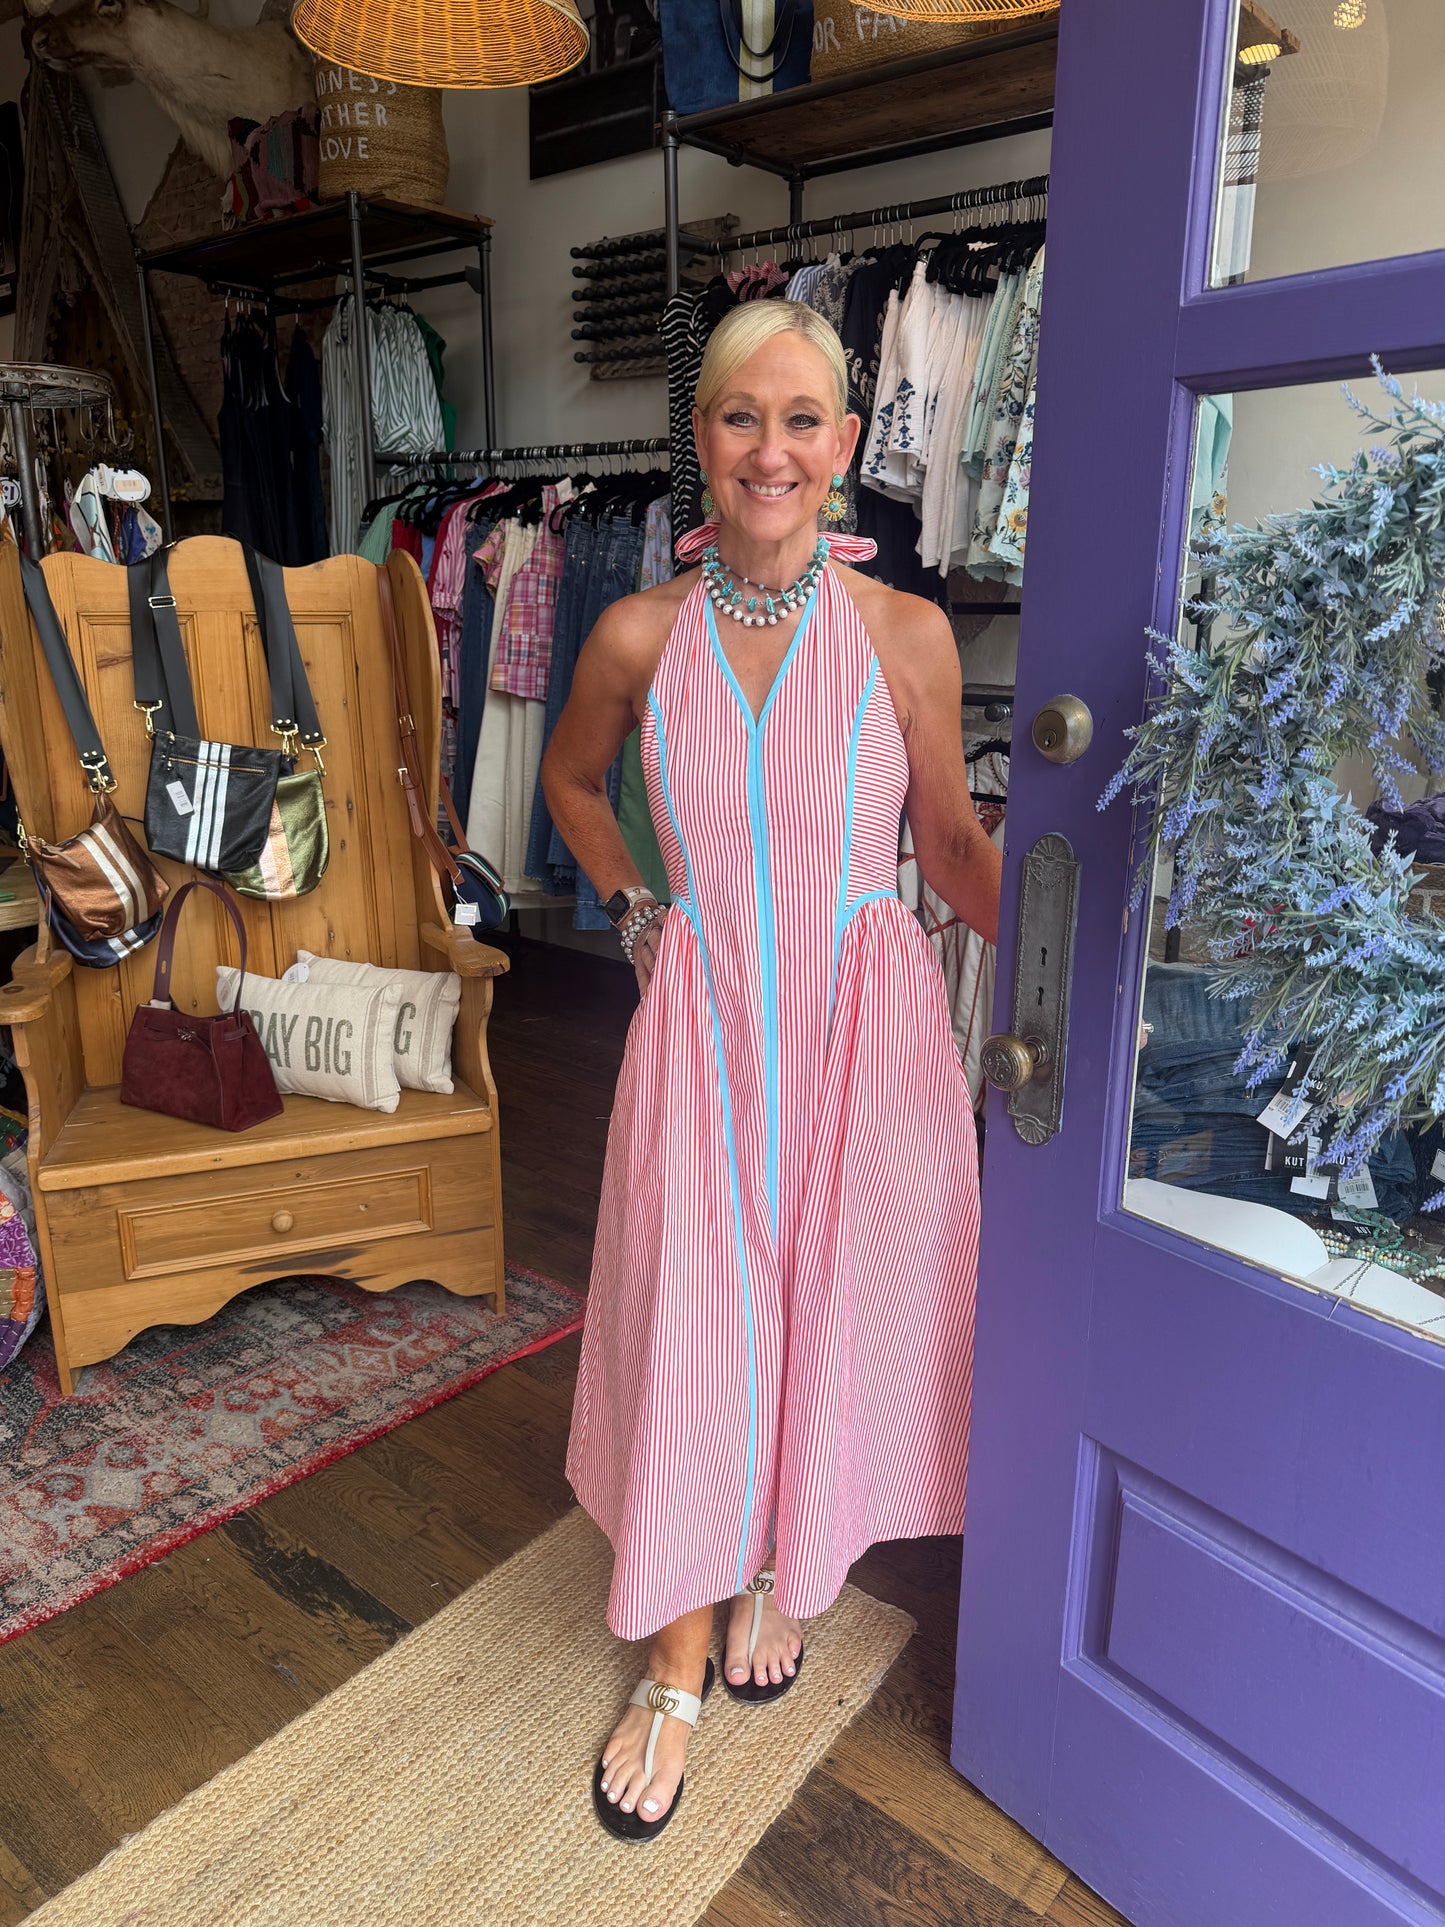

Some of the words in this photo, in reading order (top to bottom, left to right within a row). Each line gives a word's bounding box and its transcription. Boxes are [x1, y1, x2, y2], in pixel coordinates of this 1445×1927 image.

[319, 136, 369, 161] LOVE
[304, 1015, 353, 1076] BIG
[1284, 1155, 1305, 1167] KUT
